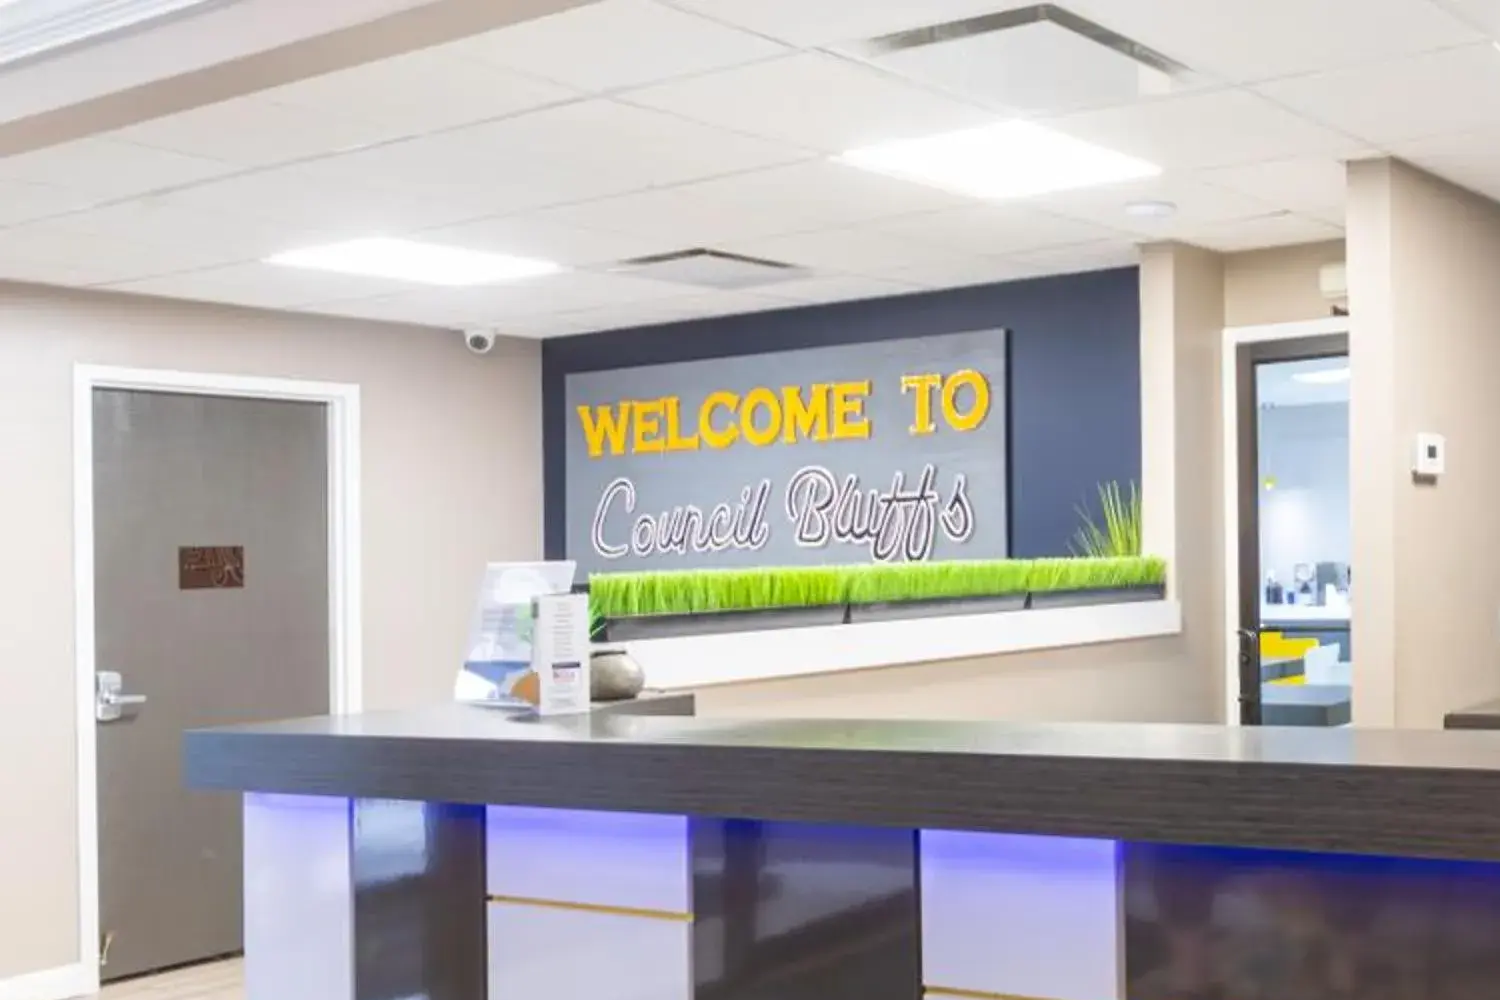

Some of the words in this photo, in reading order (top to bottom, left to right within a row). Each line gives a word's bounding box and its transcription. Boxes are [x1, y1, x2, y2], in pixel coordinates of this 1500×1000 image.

[576, 378, 873, 459] WELCOME
[901, 368, 992, 436] TO
[590, 476, 773, 560] Council
[785, 463, 976, 564] Bluffs
